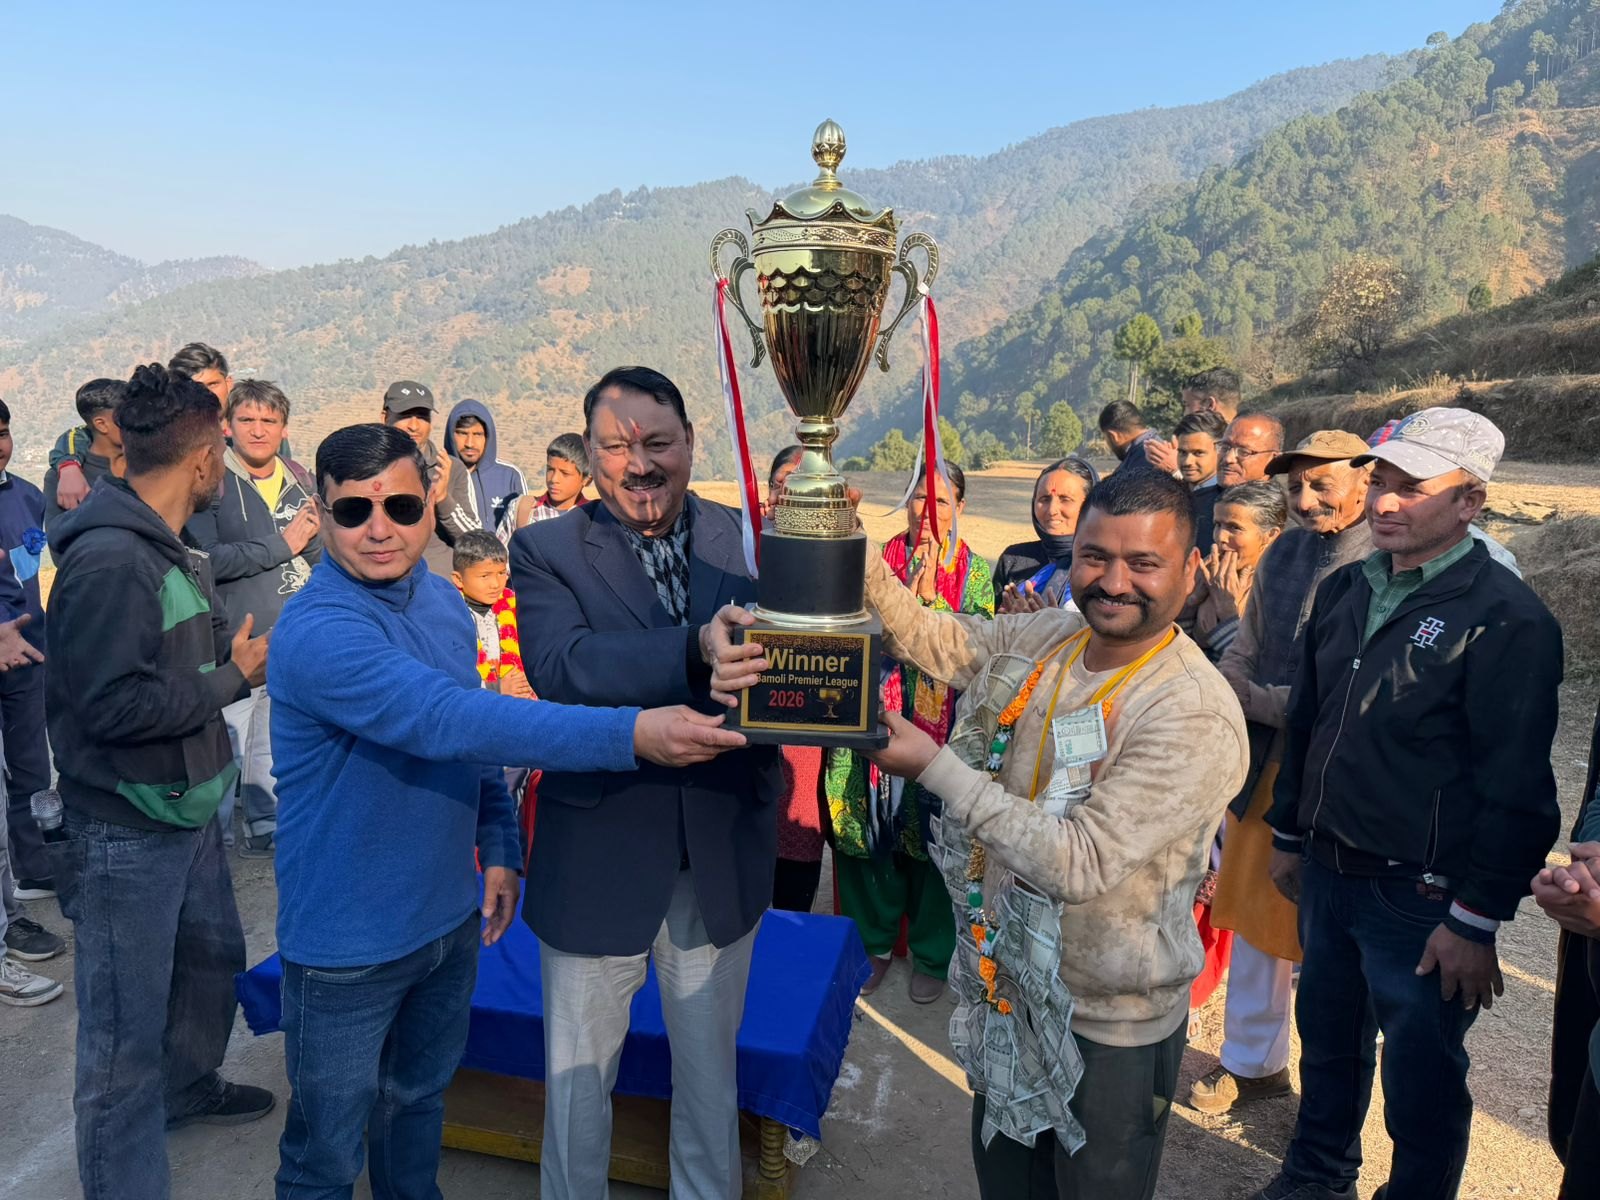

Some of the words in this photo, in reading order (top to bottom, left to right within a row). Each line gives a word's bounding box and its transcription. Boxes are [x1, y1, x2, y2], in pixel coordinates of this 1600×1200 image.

[765, 648, 849, 673] Winner
[788, 674, 823, 686] Premier
[825, 675, 858, 689] League
[768, 690, 805, 707] 2026
